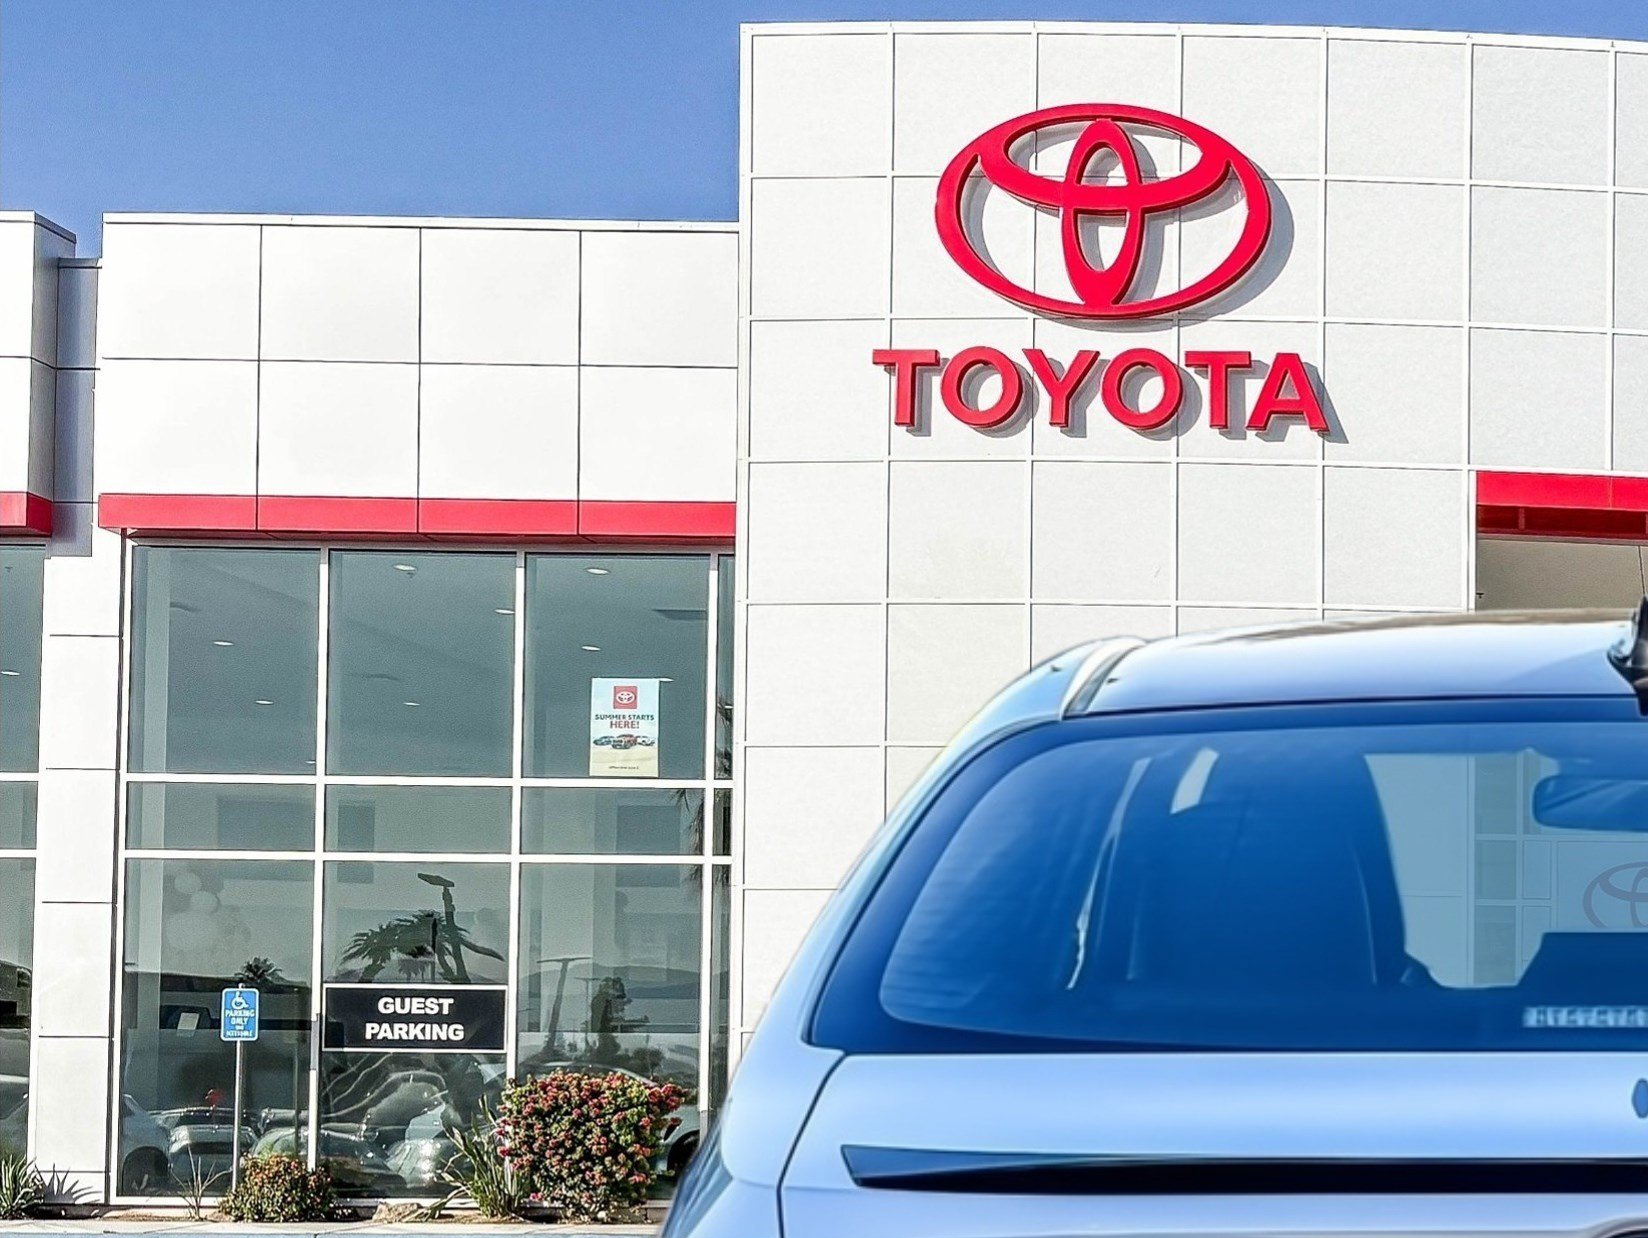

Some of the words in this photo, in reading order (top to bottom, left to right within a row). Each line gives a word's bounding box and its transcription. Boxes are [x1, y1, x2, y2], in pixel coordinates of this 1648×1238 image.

[872, 345, 1331, 435] TOYOTA
[610, 721, 640, 729] HERE!
[378, 997, 455, 1015] GUEST
[365, 1022, 465, 1041] PARKING
